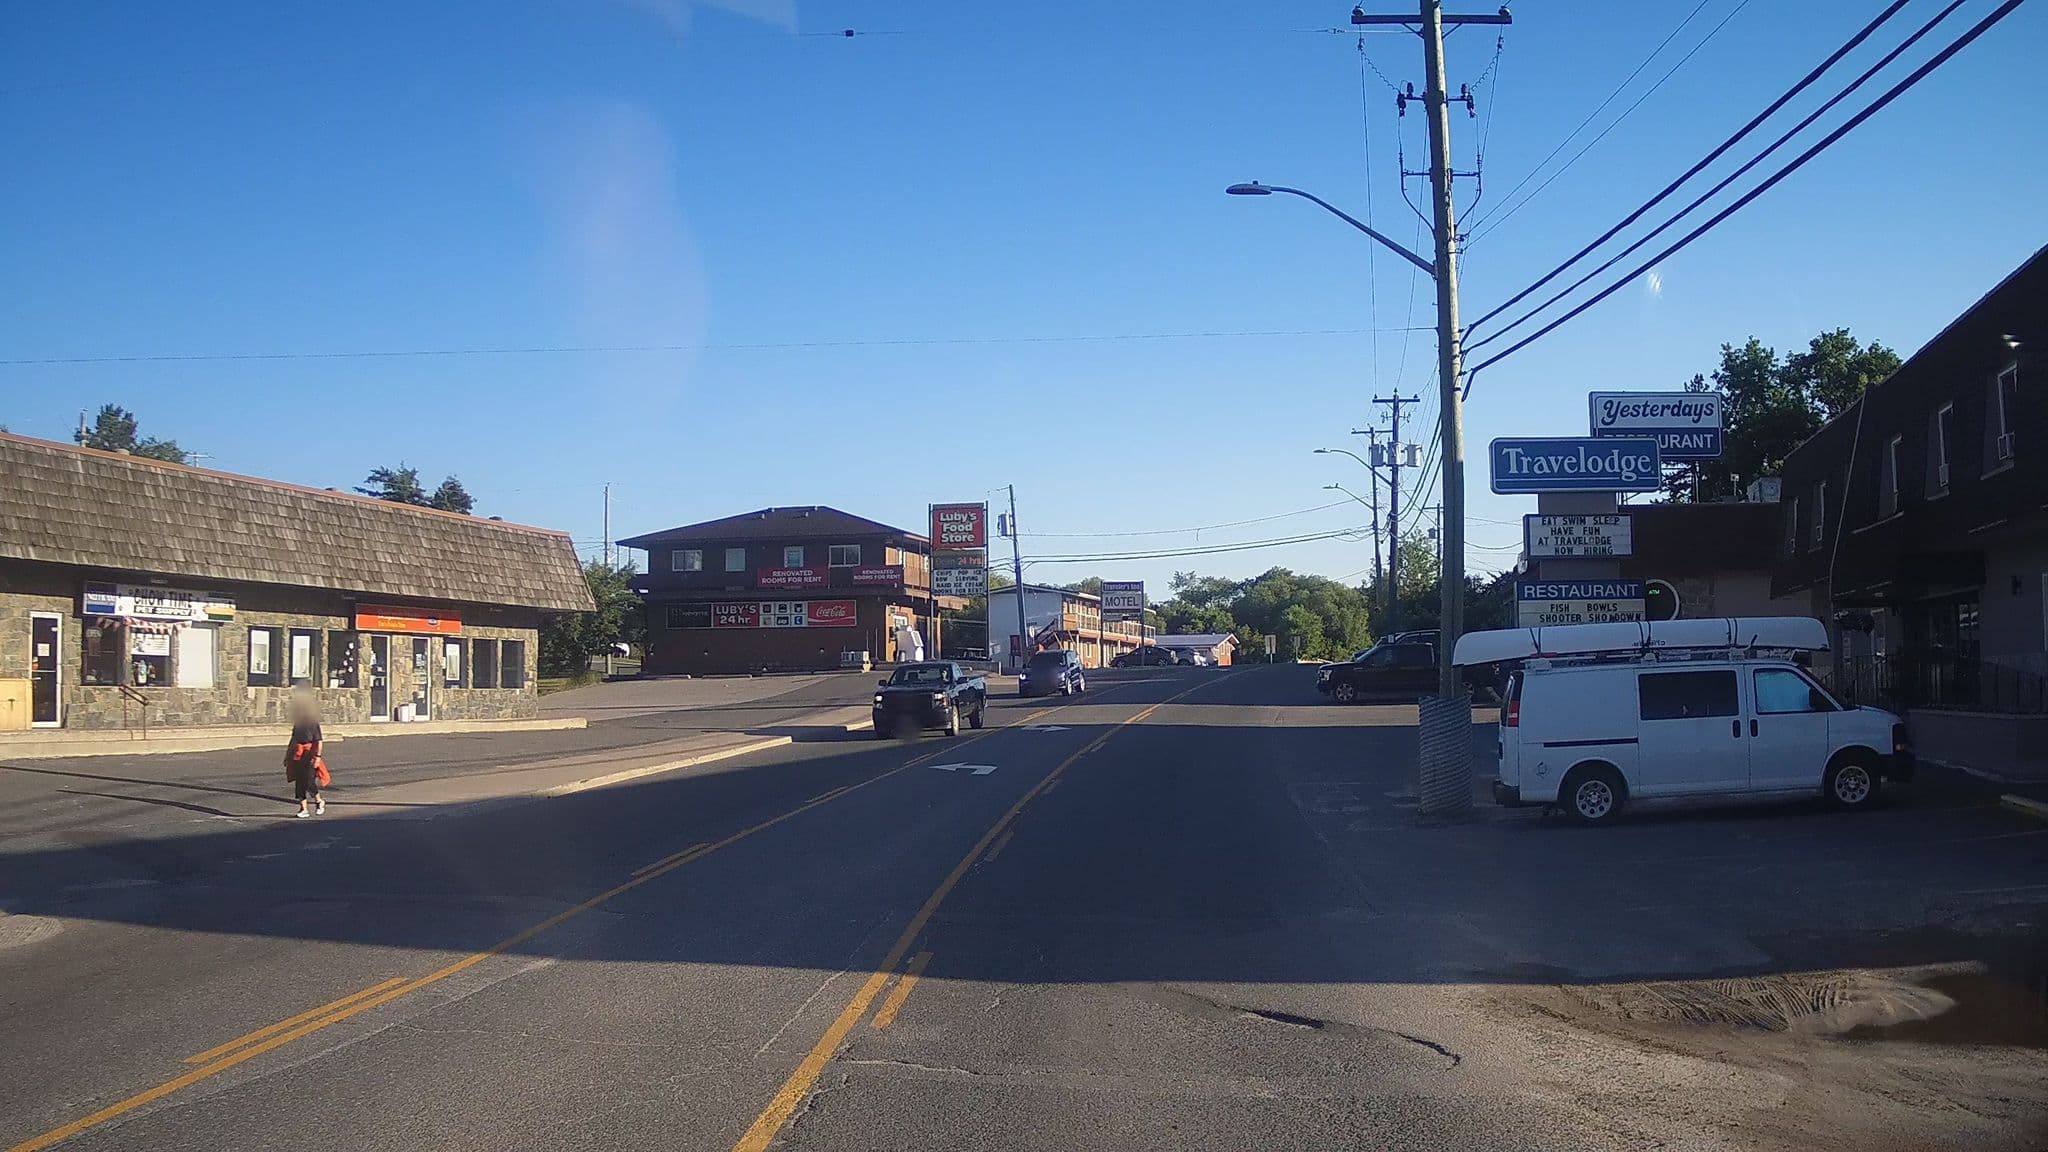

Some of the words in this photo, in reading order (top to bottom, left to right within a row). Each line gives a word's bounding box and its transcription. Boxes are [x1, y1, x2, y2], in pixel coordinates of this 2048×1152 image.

[1601, 400, 1714, 425] Yesterdays
[1502, 447, 1651, 481] Travelodge
[940, 512, 977, 522] Luby's
[1541, 517, 1558, 526] EAT
[1563, 516, 1586, 525] SWIM
[943, 523, 973, 532] Food
[1550, 527, 1574, 536] HAVE
[1583, 527, 1600, 535] FUN
[941, 533, 975, 543] Store
[1538, 537, 1549, 546] AT
[1554, 536, 1612, 545] TRAVELODGE
[1554, 547, 1574, 555] NOW
[1584, 547, 1613, 555] HIRING
[1524, 583, 1638, 598] RESTAURANT
[168, 590, 193, 608] TIME
[1105, 597, 1139, 606] MOTEL
[716, 604, 757, 615] LUBY'S
[1550, 603, 1570, 612] FISH
[1587, 603, 1618, 612] BOWLS
[720, 616, 735, 624] 24
[1539, 614, 1582, 623] SHOOTER
